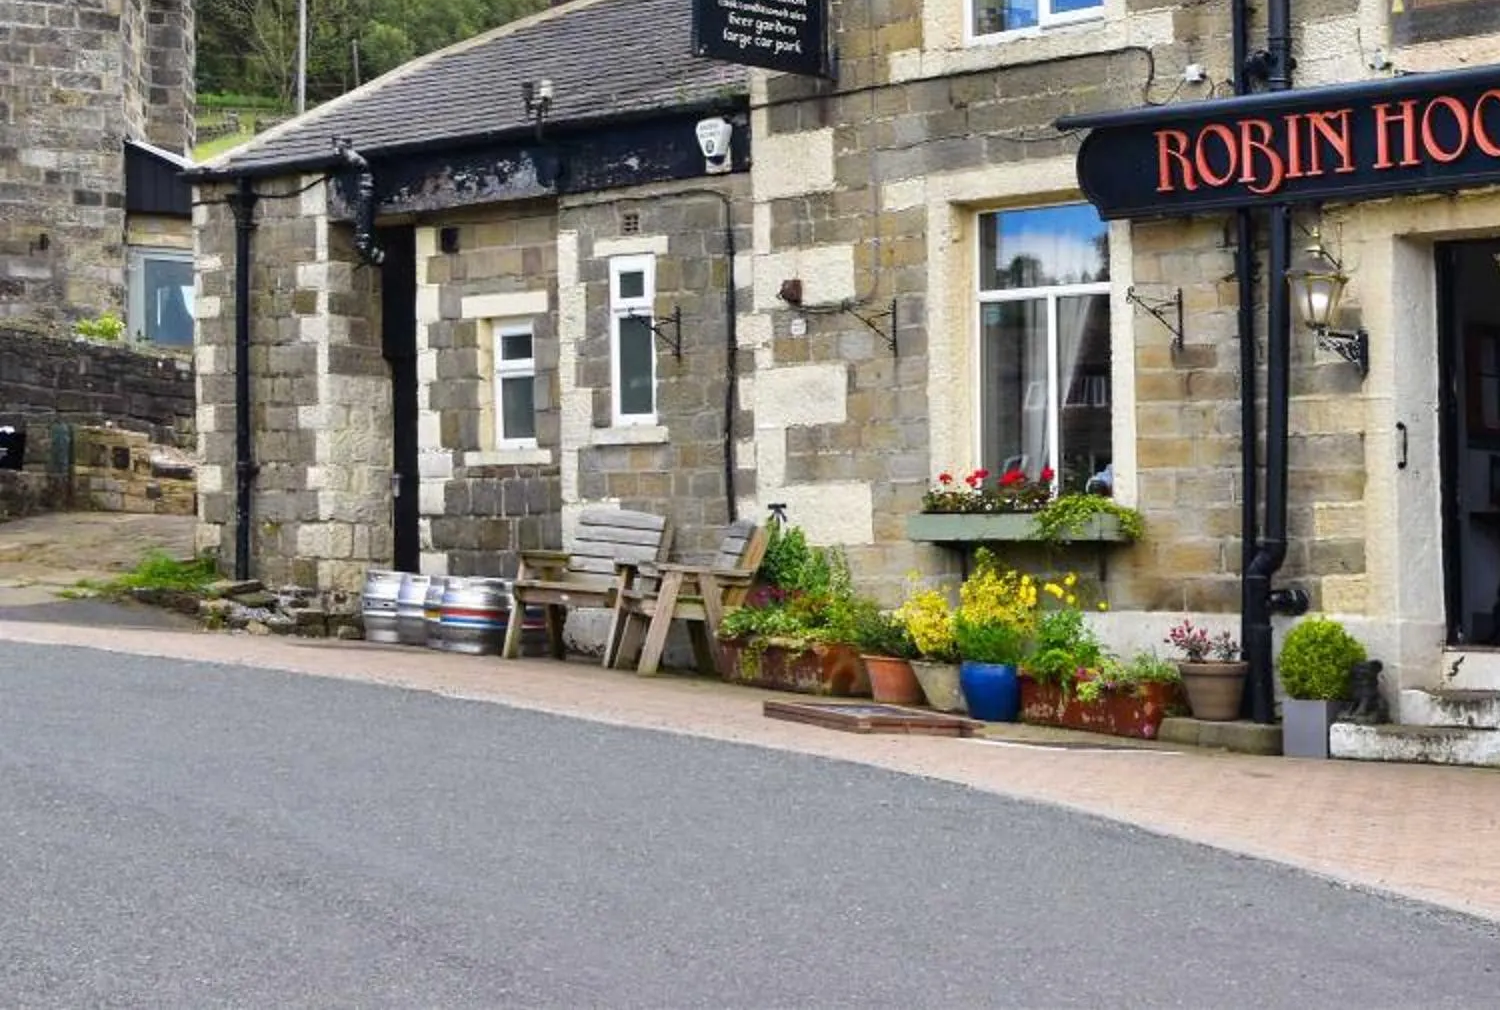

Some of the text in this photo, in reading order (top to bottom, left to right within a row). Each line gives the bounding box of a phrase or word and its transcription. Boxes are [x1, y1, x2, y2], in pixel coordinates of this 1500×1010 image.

[728, 11, 797, 36] beer garden
[723, 26, 803, 55] large car park
[1154, 108, 1354, 194] ROBIN
